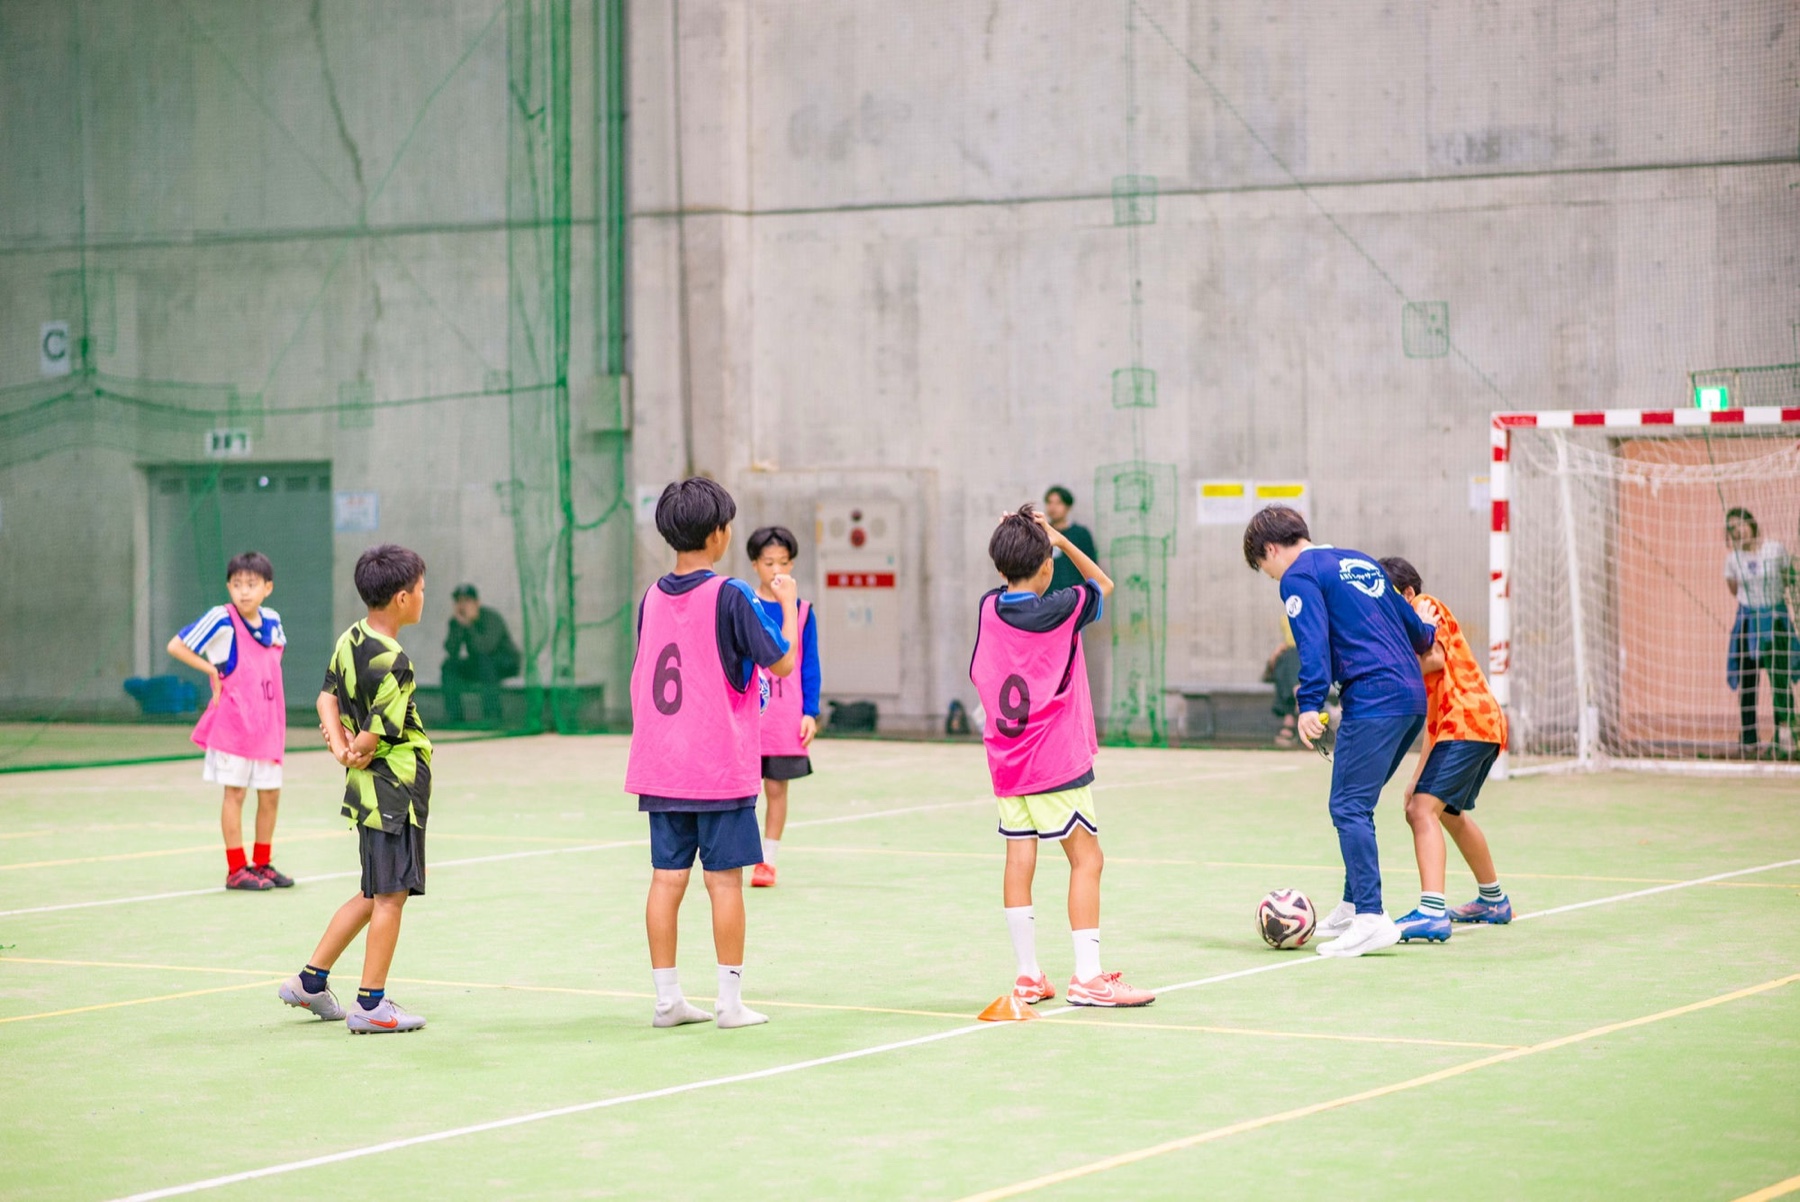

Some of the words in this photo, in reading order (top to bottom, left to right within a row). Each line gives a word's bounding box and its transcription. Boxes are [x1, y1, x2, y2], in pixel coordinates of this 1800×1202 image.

[43, 329, 65, 361] C
[261, 680, 274, 701] 10
[652, 642, 682, 716] 6
[996, 673, 1030, 738] 9
